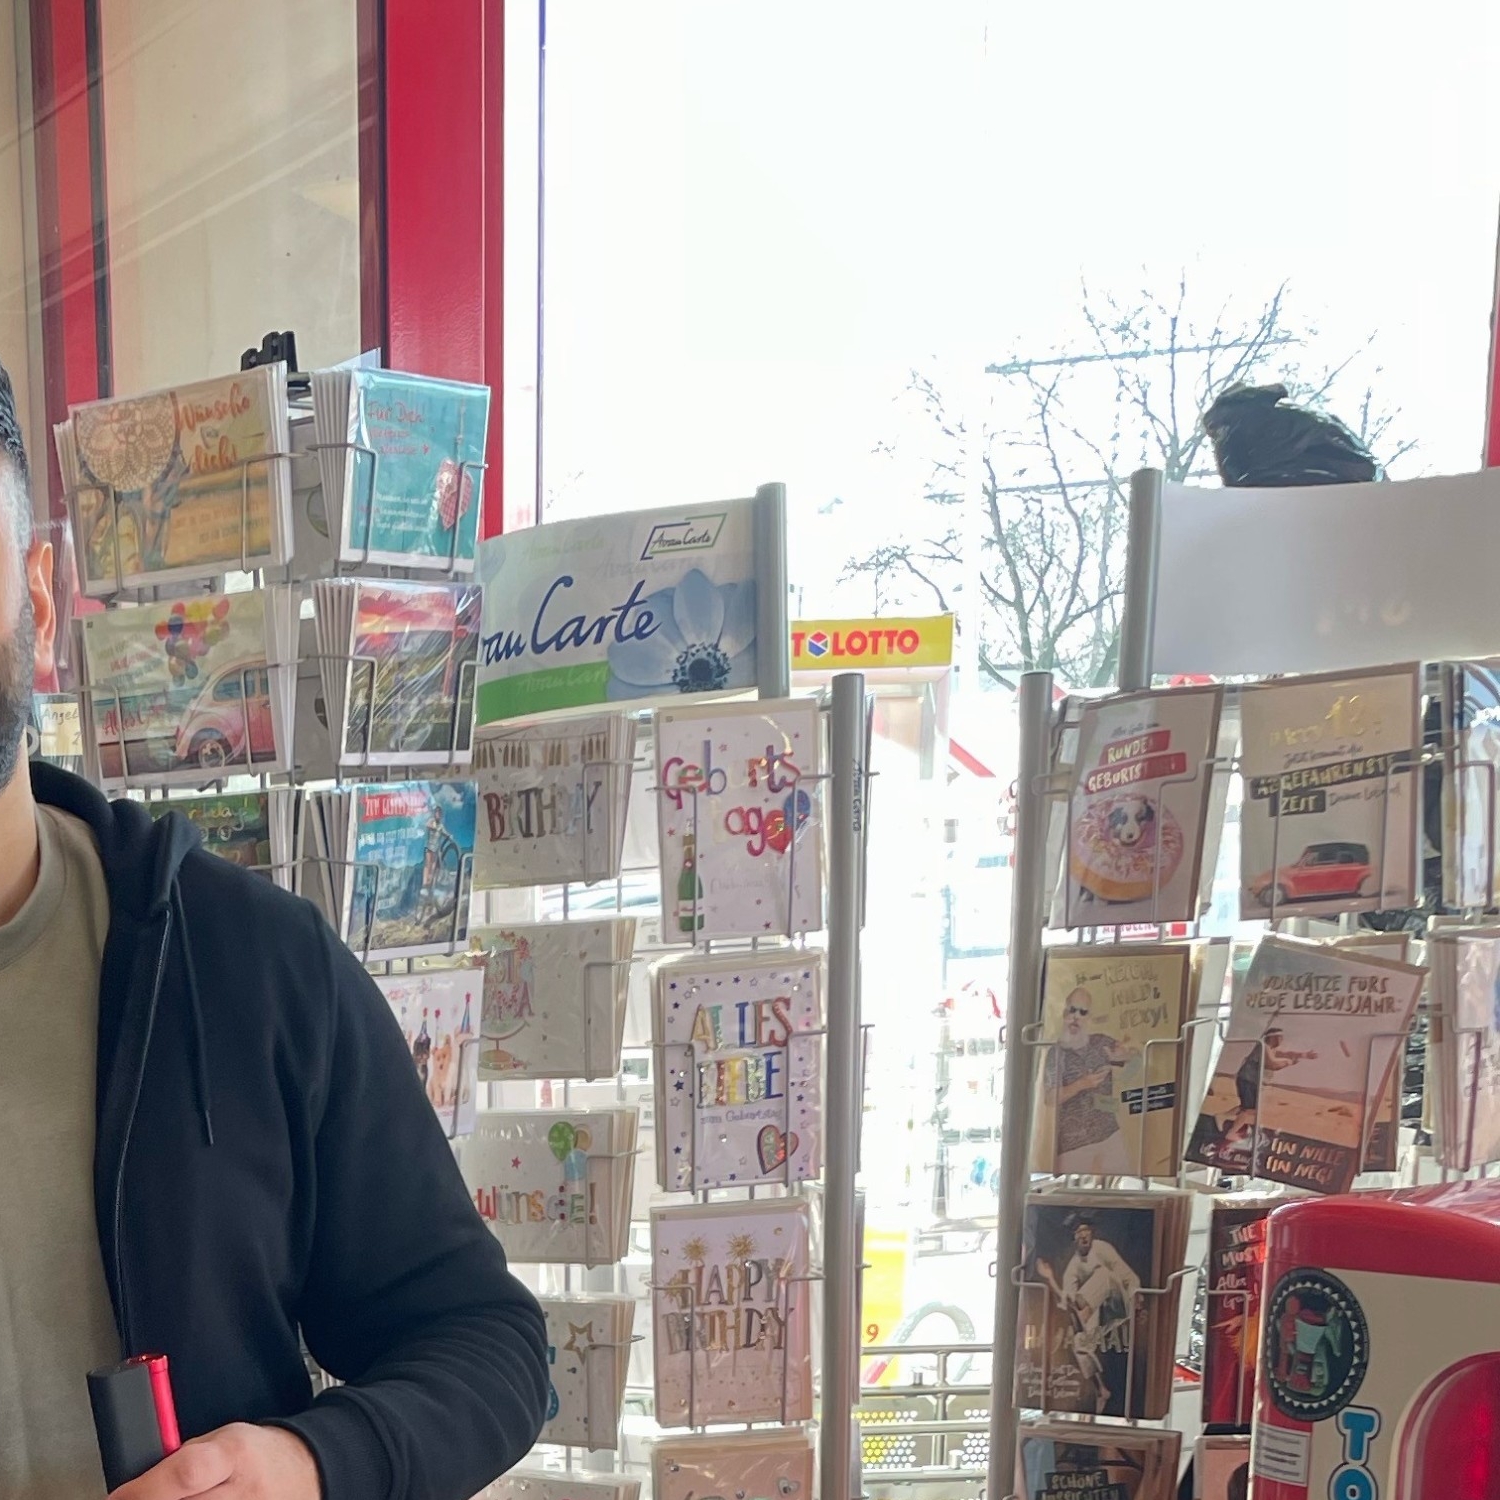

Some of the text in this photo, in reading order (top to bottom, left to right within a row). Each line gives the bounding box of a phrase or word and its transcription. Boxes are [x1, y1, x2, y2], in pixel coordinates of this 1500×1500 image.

[831, 629, 920, 657] LOTTO
[484, 780, 602, 843] BIRTHDAY
[1262, 973, 1342, 993] VORSÄTZE
[1293, 993, 1397, 1014] LEBENSJAHR
[690, 996, 794, 1052] ALLES
[678, 1258, 786, 1308] HAPPY
[663, 1306, 795, 1356] BIRTHDAY
[1051, 1472, 1105, 1490] SCHÖNE
